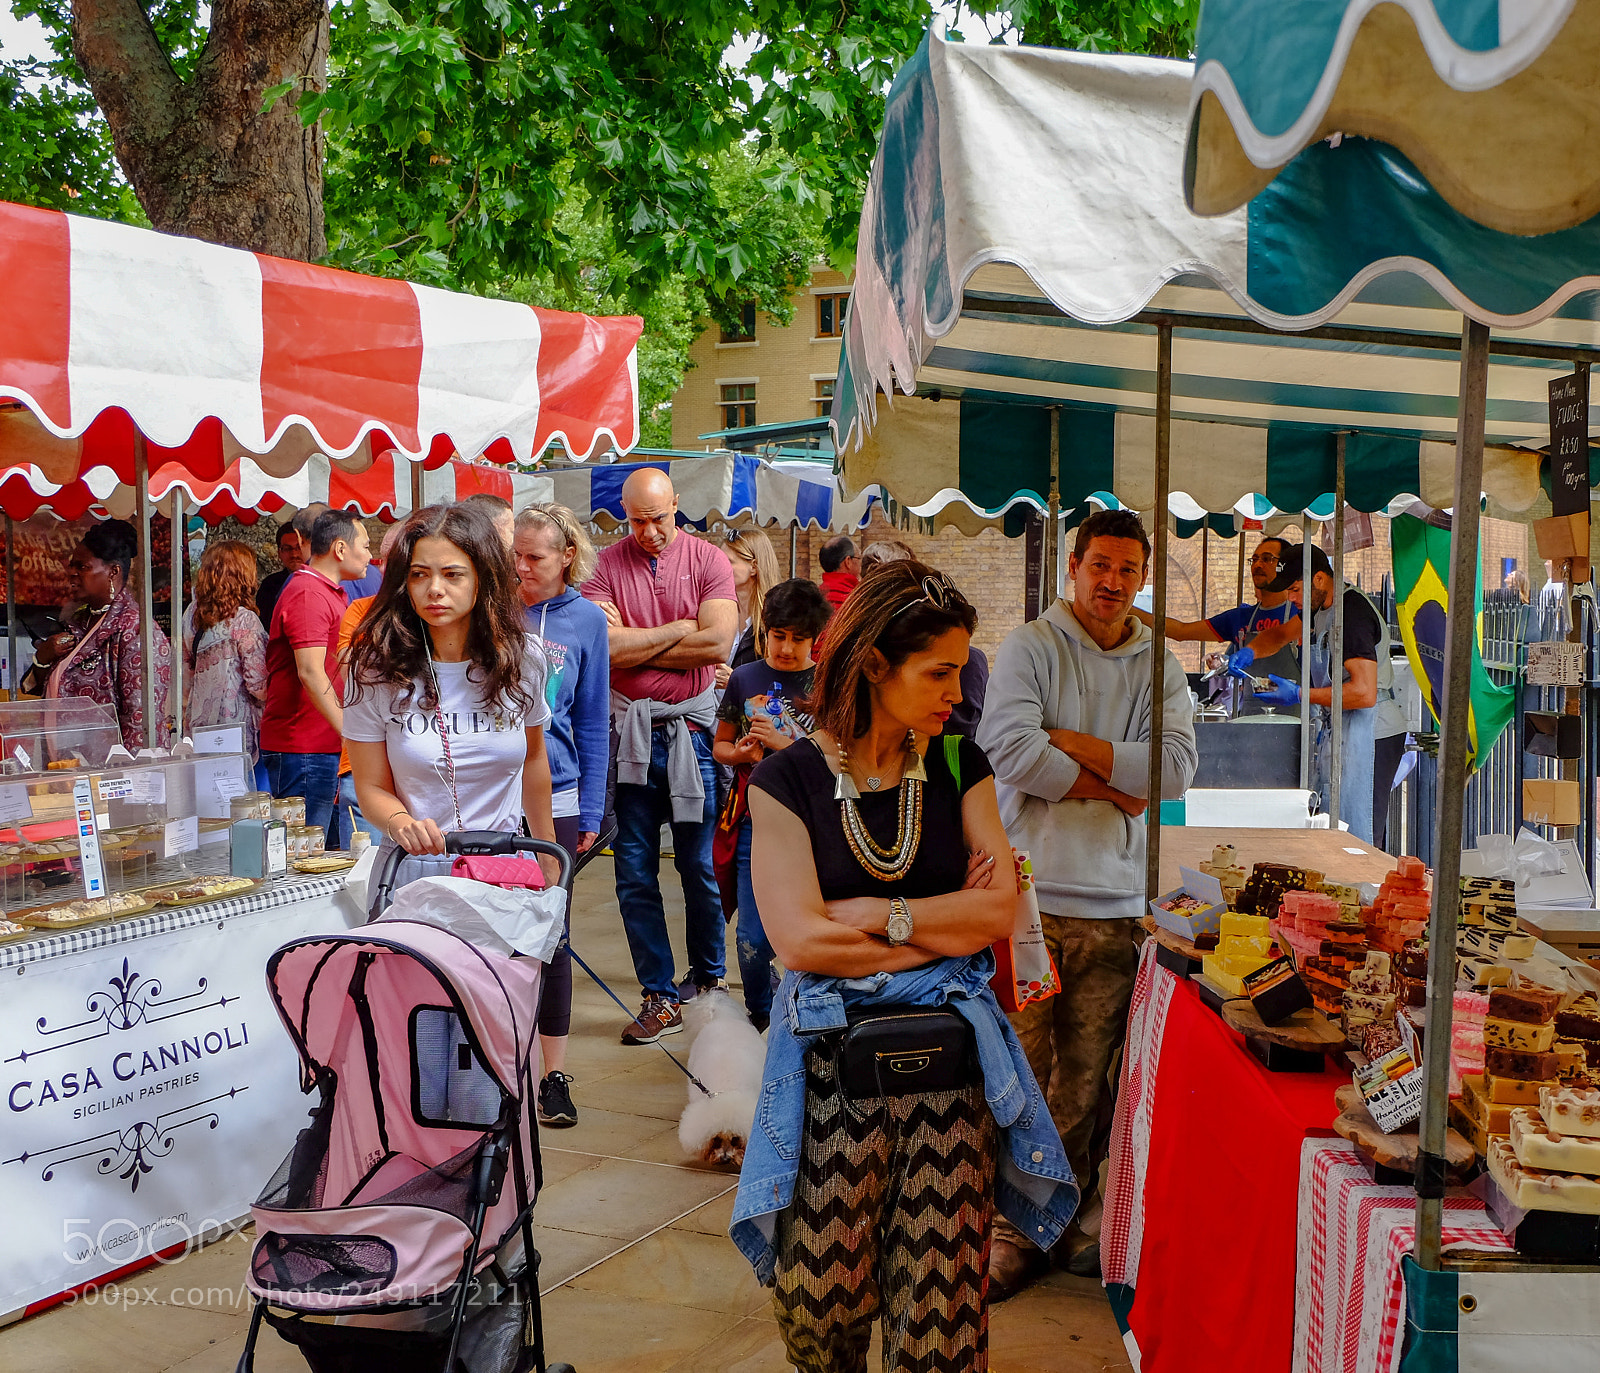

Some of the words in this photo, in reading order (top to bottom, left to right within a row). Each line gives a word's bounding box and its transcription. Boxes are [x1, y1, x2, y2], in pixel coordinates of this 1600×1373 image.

[73, 1091, 135, 1119] SICILIAN
[139, 1072, 200, 1100] PASTRIES
[76, 1211, 189, 1261] www.casacannoli.com
